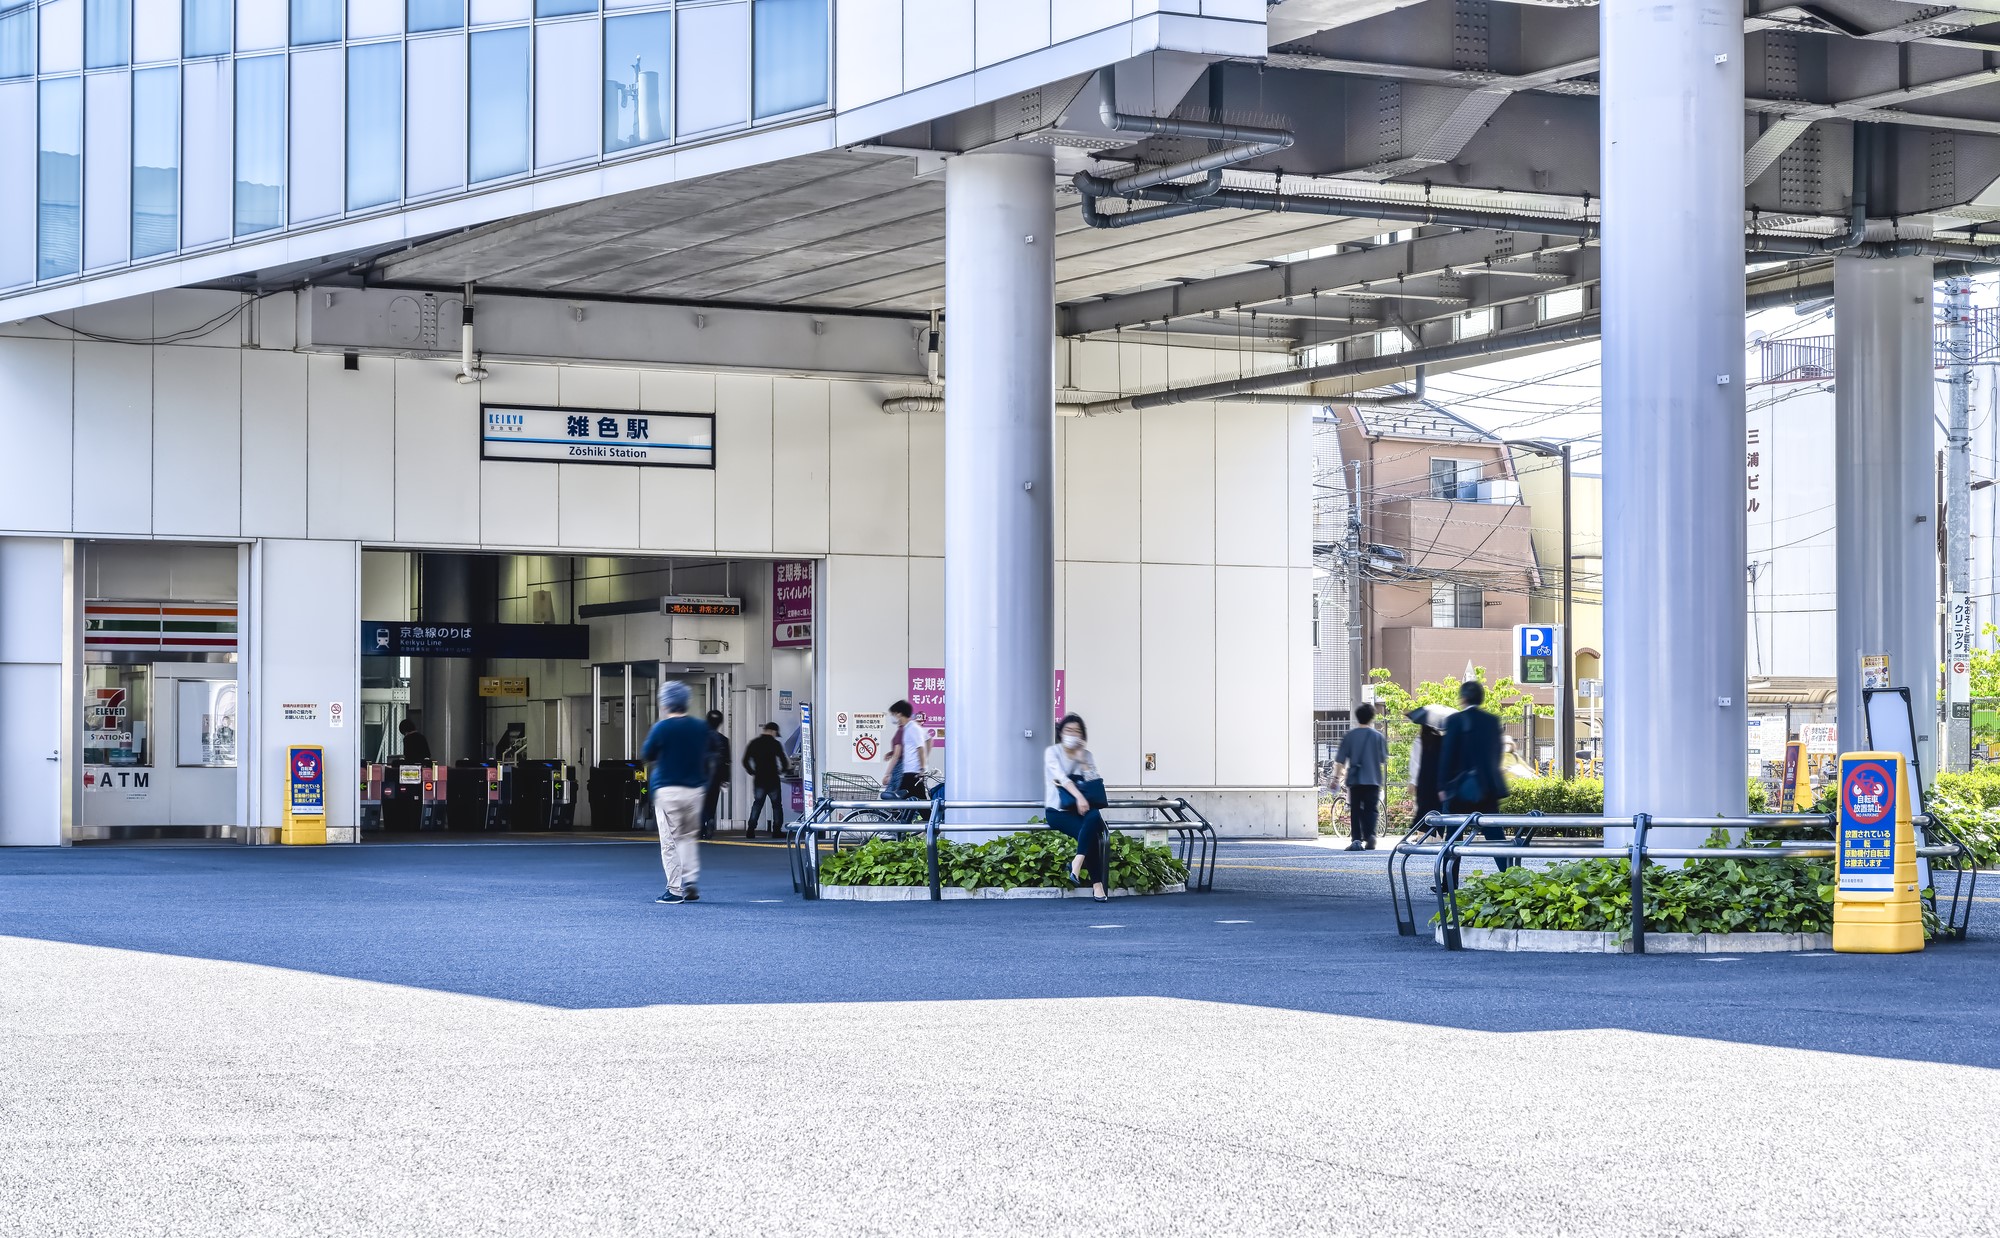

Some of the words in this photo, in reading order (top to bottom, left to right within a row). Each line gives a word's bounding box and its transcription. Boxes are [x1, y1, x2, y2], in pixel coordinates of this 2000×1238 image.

[489, 414, 523, 425] KEIKYU
[567, 415, 649, 440] 雑色駅
[569, 446, 607, 458] Zōshiki
[609, 447, 647, 459] Station
[1747, 429, 1760, 513] 三浦ビル
[400, 627, 472, 638] 京急線のりば
[1954, 604, 1964, 650] クリニック
[400, 639, 425, 647] Keikyu
[1526, 629, 1544, 655] P
[1527, 659, 1545, 681] 空
[97, 688, 126, 728] 7
[90, 733, 125, 741] STATION
[100, 772, 149, 788] ATM
[1857, 795, 1879, 803] 自転車
[1853, 803, 1882, 813] 放置禁止
[1844, 830, 1891, 839] 放置されている
[1844, 849, 1890, 858] 原動機付自転車
[1844, 859, 1882, 867] は撤去します
